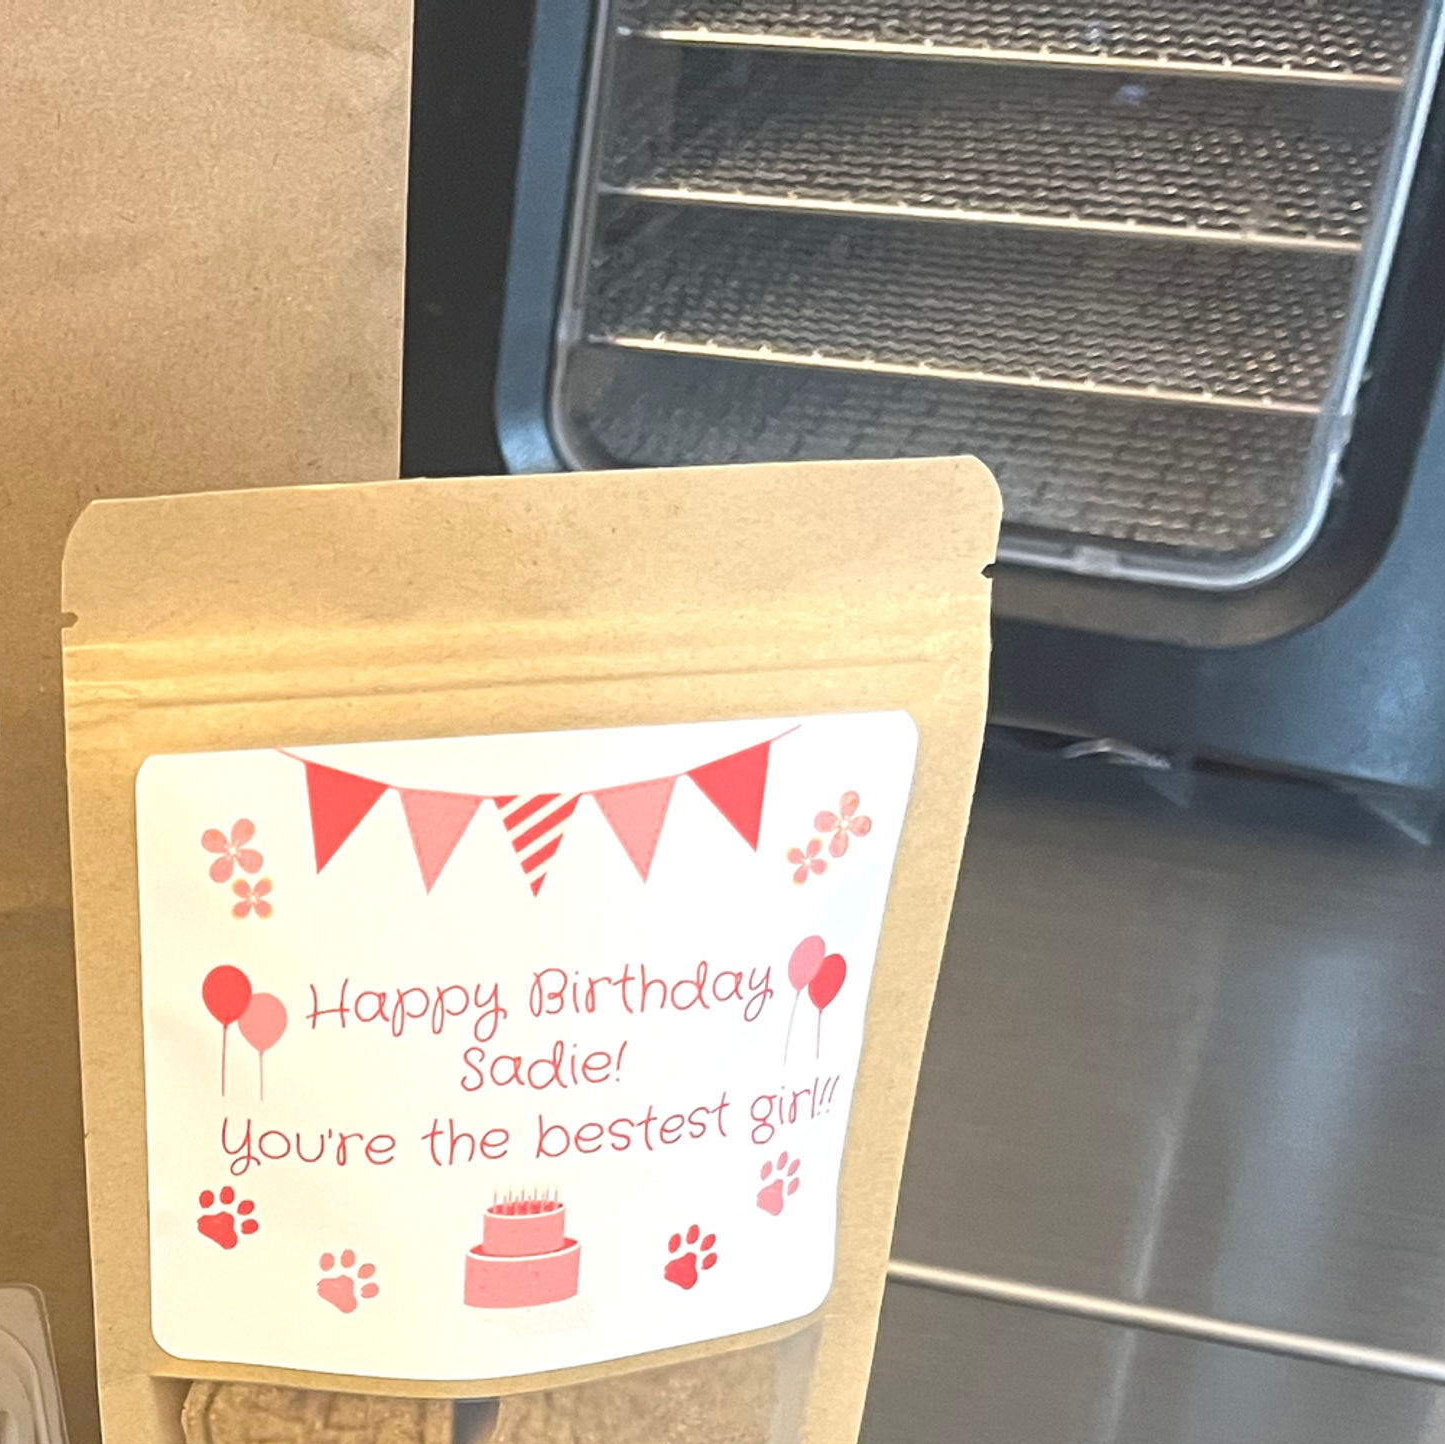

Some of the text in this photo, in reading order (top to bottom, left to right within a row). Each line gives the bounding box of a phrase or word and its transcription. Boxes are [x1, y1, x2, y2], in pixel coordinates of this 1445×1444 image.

[306, 961, 774, 1041] Happy Birthday
[460, 1041, 627, 1091] Sadie!
[221, 1075, 841, 1176] You're the bestest girl!!
